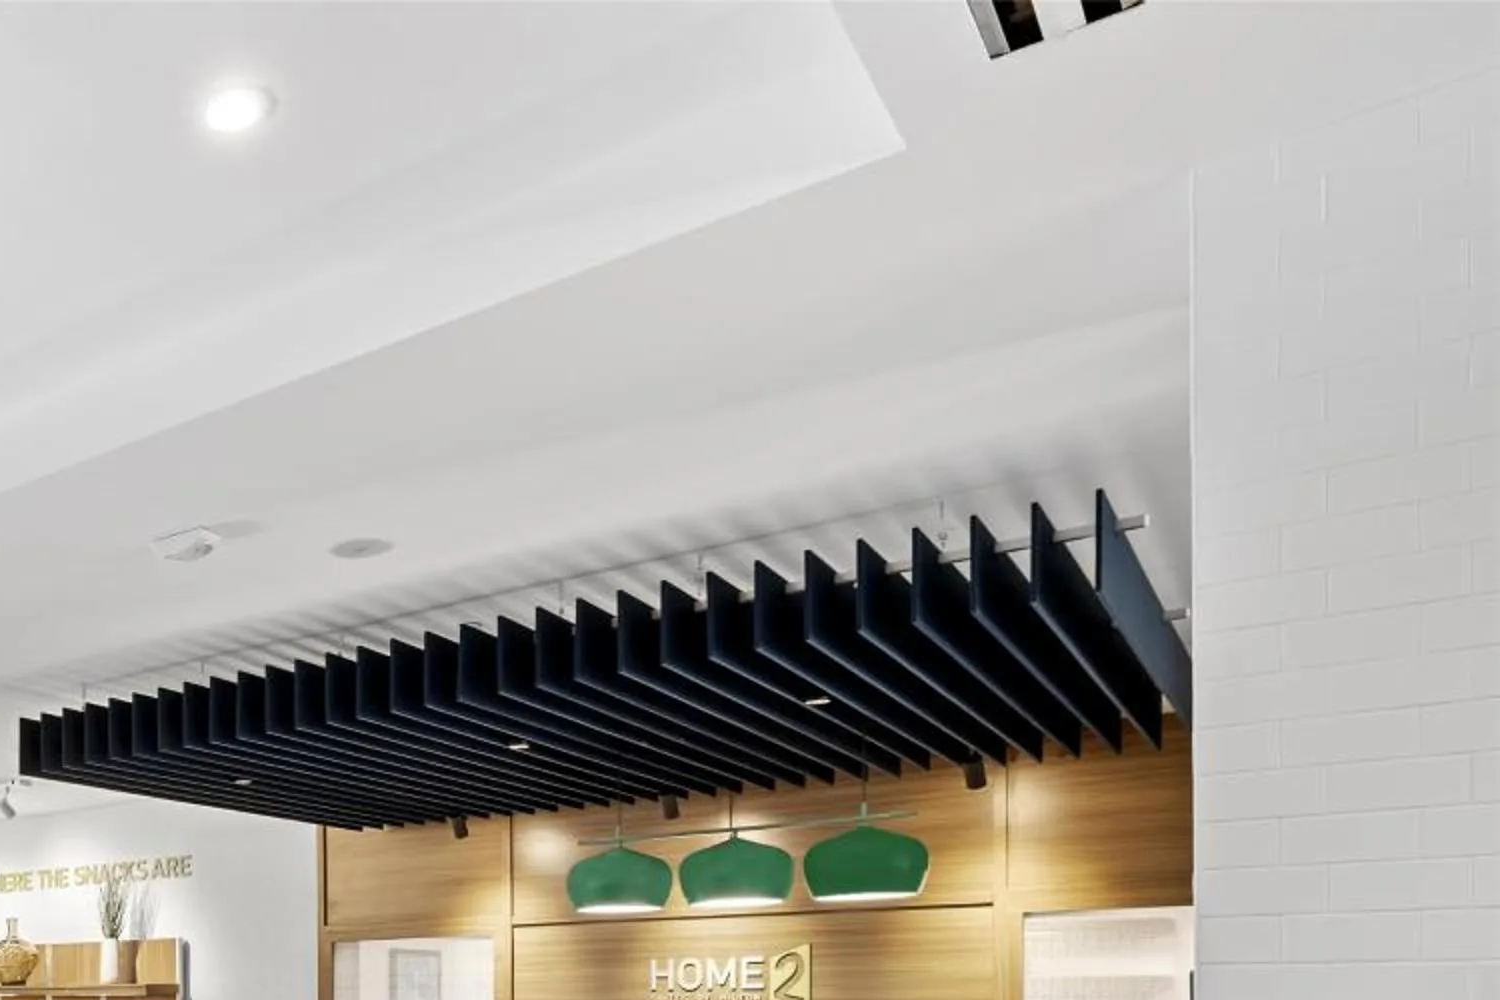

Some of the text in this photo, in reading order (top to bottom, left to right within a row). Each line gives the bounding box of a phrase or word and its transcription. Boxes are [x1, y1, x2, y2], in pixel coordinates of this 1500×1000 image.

[37, 866, 70, 889] THE
[74, 859, 150, 887] SNACKS
[151, 854, 194, 880] ARE
[651, 956, 766, 993] HOME
